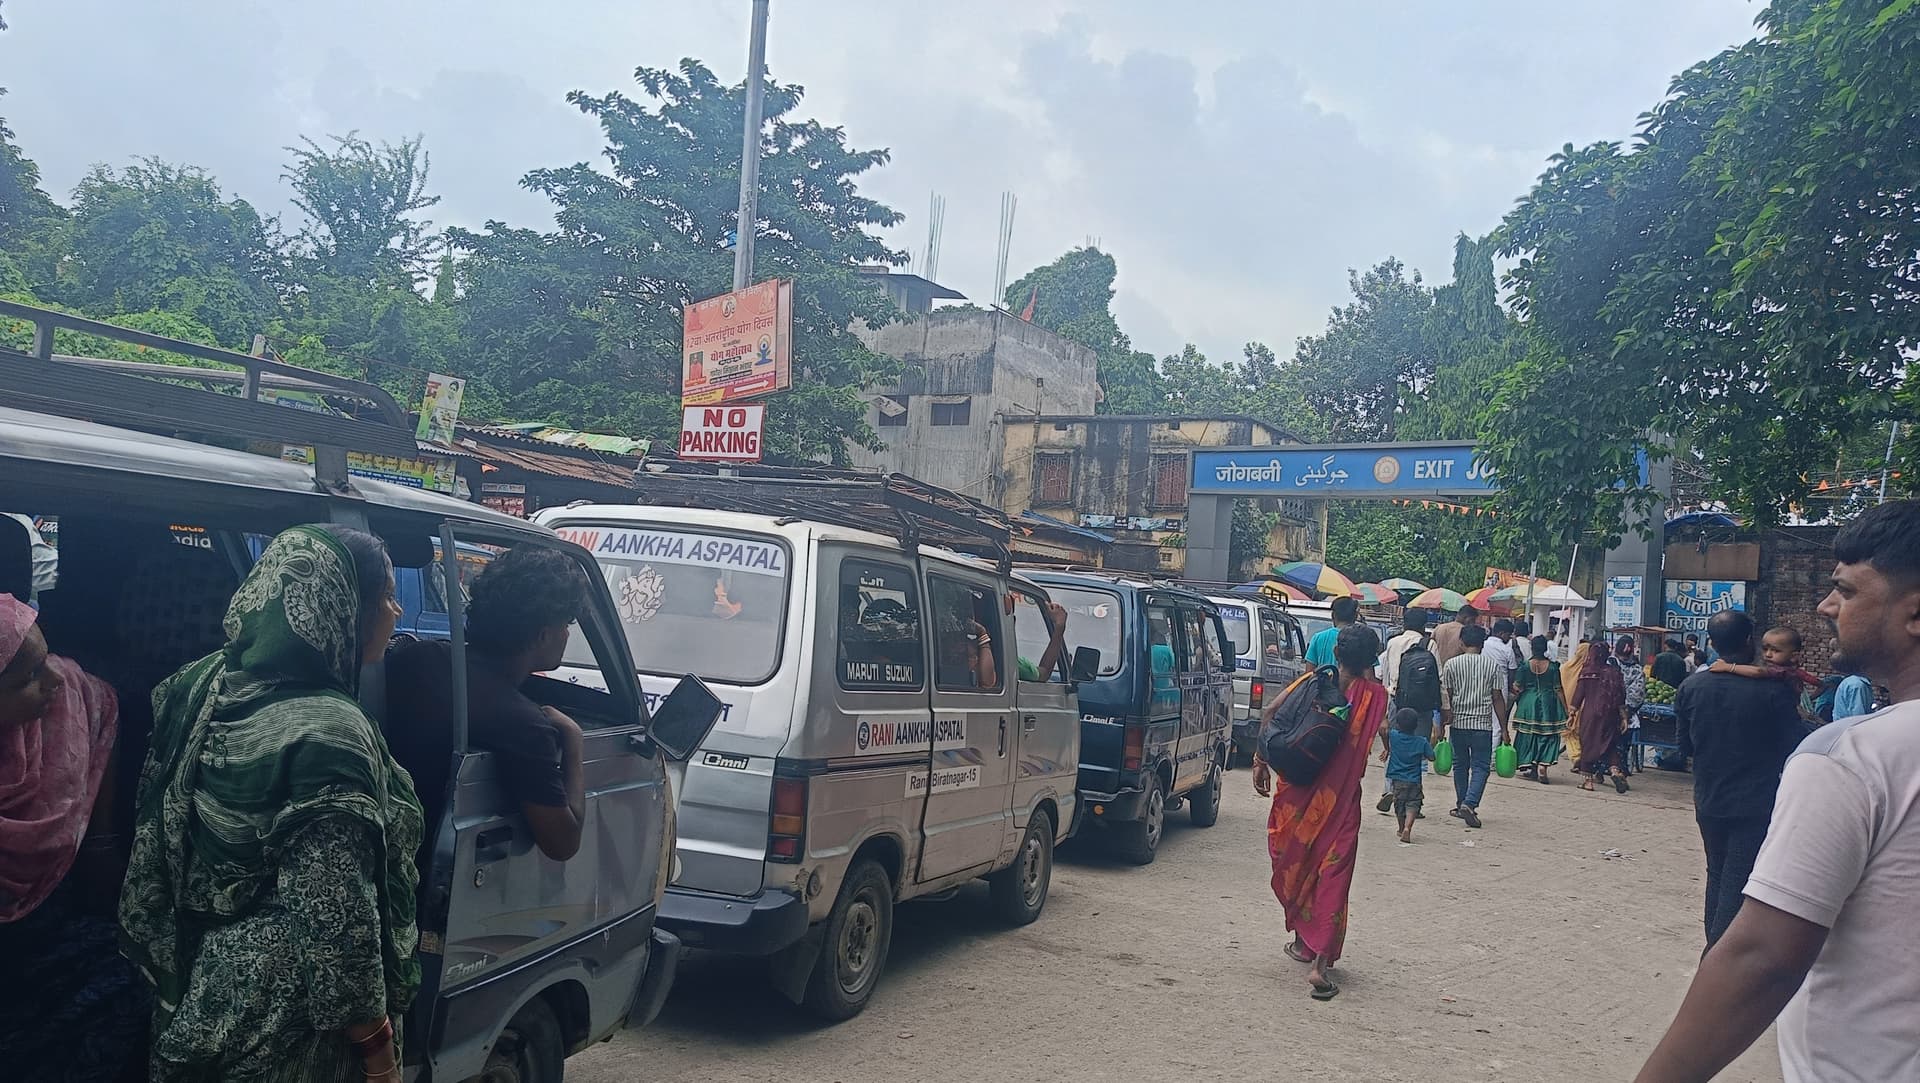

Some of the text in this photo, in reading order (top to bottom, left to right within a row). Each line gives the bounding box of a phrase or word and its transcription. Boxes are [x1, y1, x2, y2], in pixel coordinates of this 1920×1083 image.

[703, 409, 746, 427] NO
[682, 431, 757, 453] PARKING
[1216, 460, 1282, 482] जोगबनी
[1414, 459, 1454, 479] EXIT
[598, 532, 683, 559] AANKHA
[686, 540, 782, 571] ASPATAL
[1677, 591, 1733, 614] बालाजी
[1666, 610, 1712, 630] किरान
[847, 662, 913, 682] MARUTI SUZUKI
[871, 719, 964, 747] RANI AANKHA ASPATAL
[705, 754, 748, 769] Omni
[932, 768, 976, 787] Biratnagar-15
[447, 955, 488, 977] Omni
